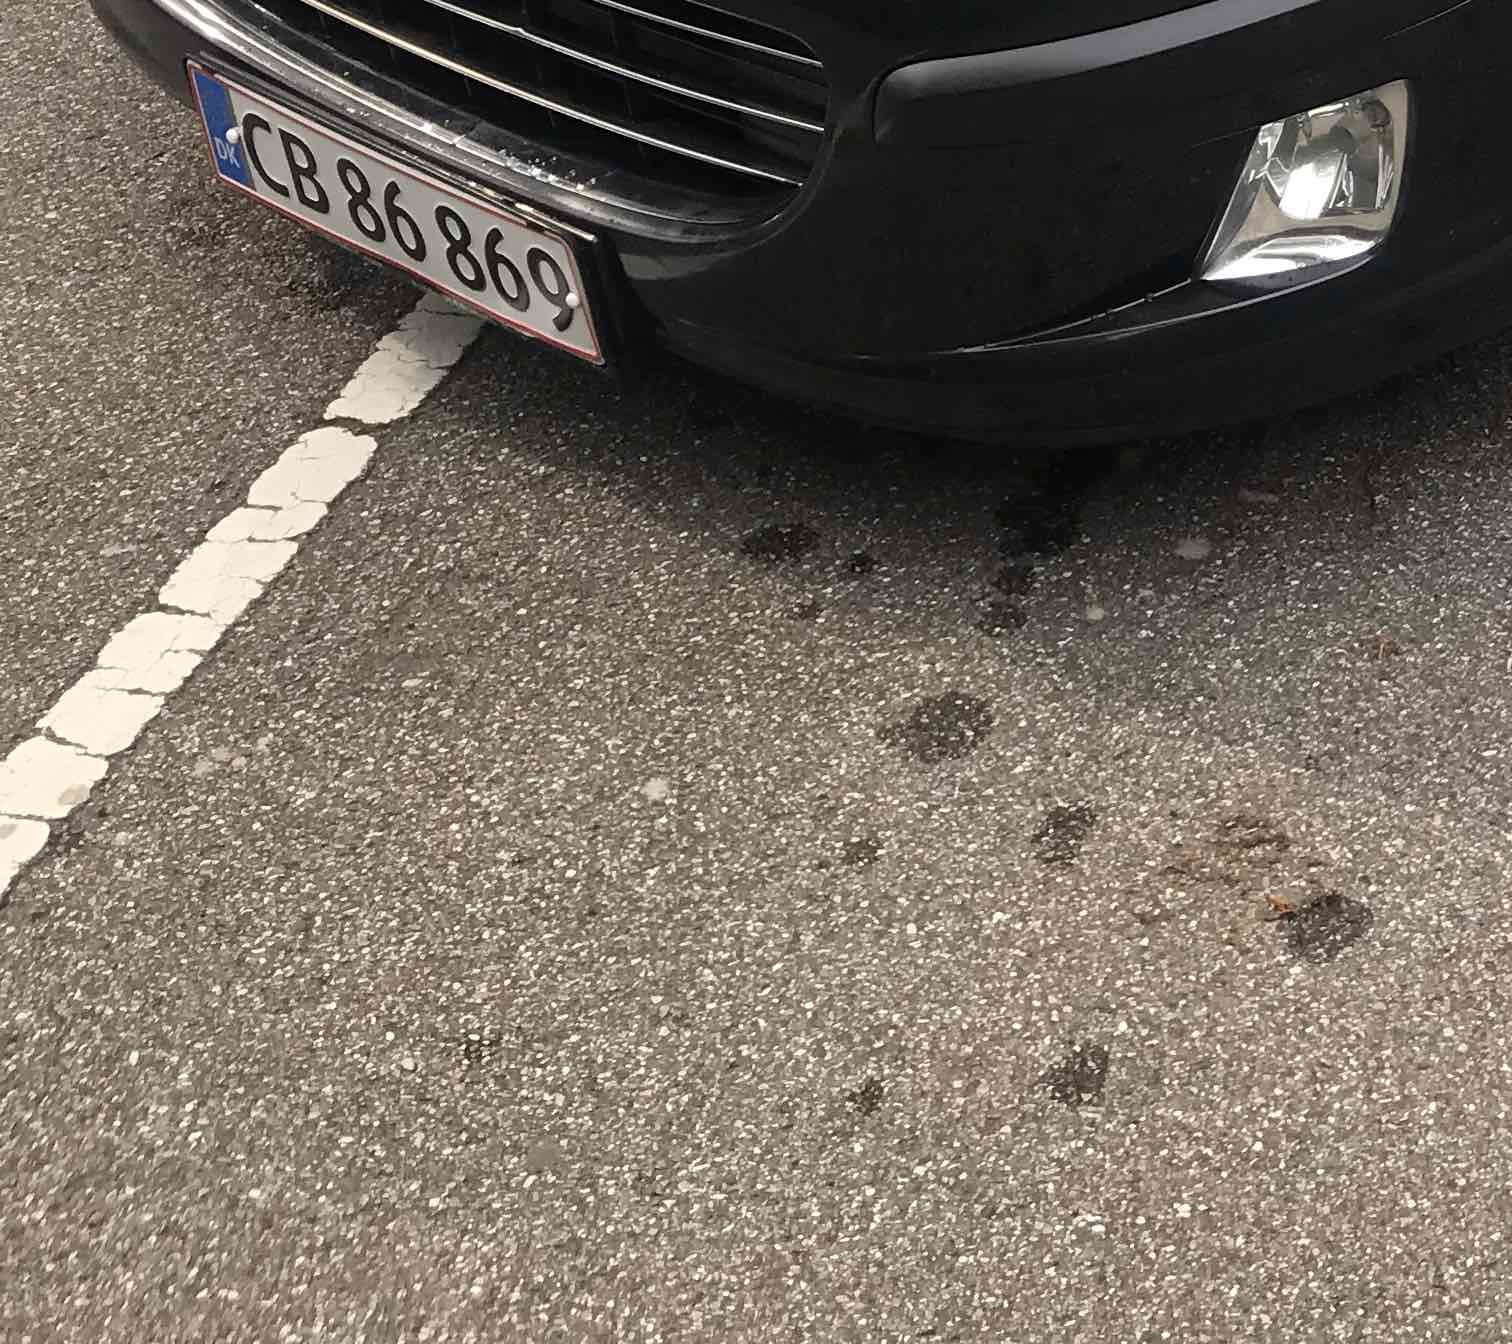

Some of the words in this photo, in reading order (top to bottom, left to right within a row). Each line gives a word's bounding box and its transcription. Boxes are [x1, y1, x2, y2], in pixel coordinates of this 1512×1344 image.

[214, 137, 241, 169] DK
[242, 112, 329, 214] CB
[337, 157, 426, 263] 86
[435, 205, 575, 332] 869
